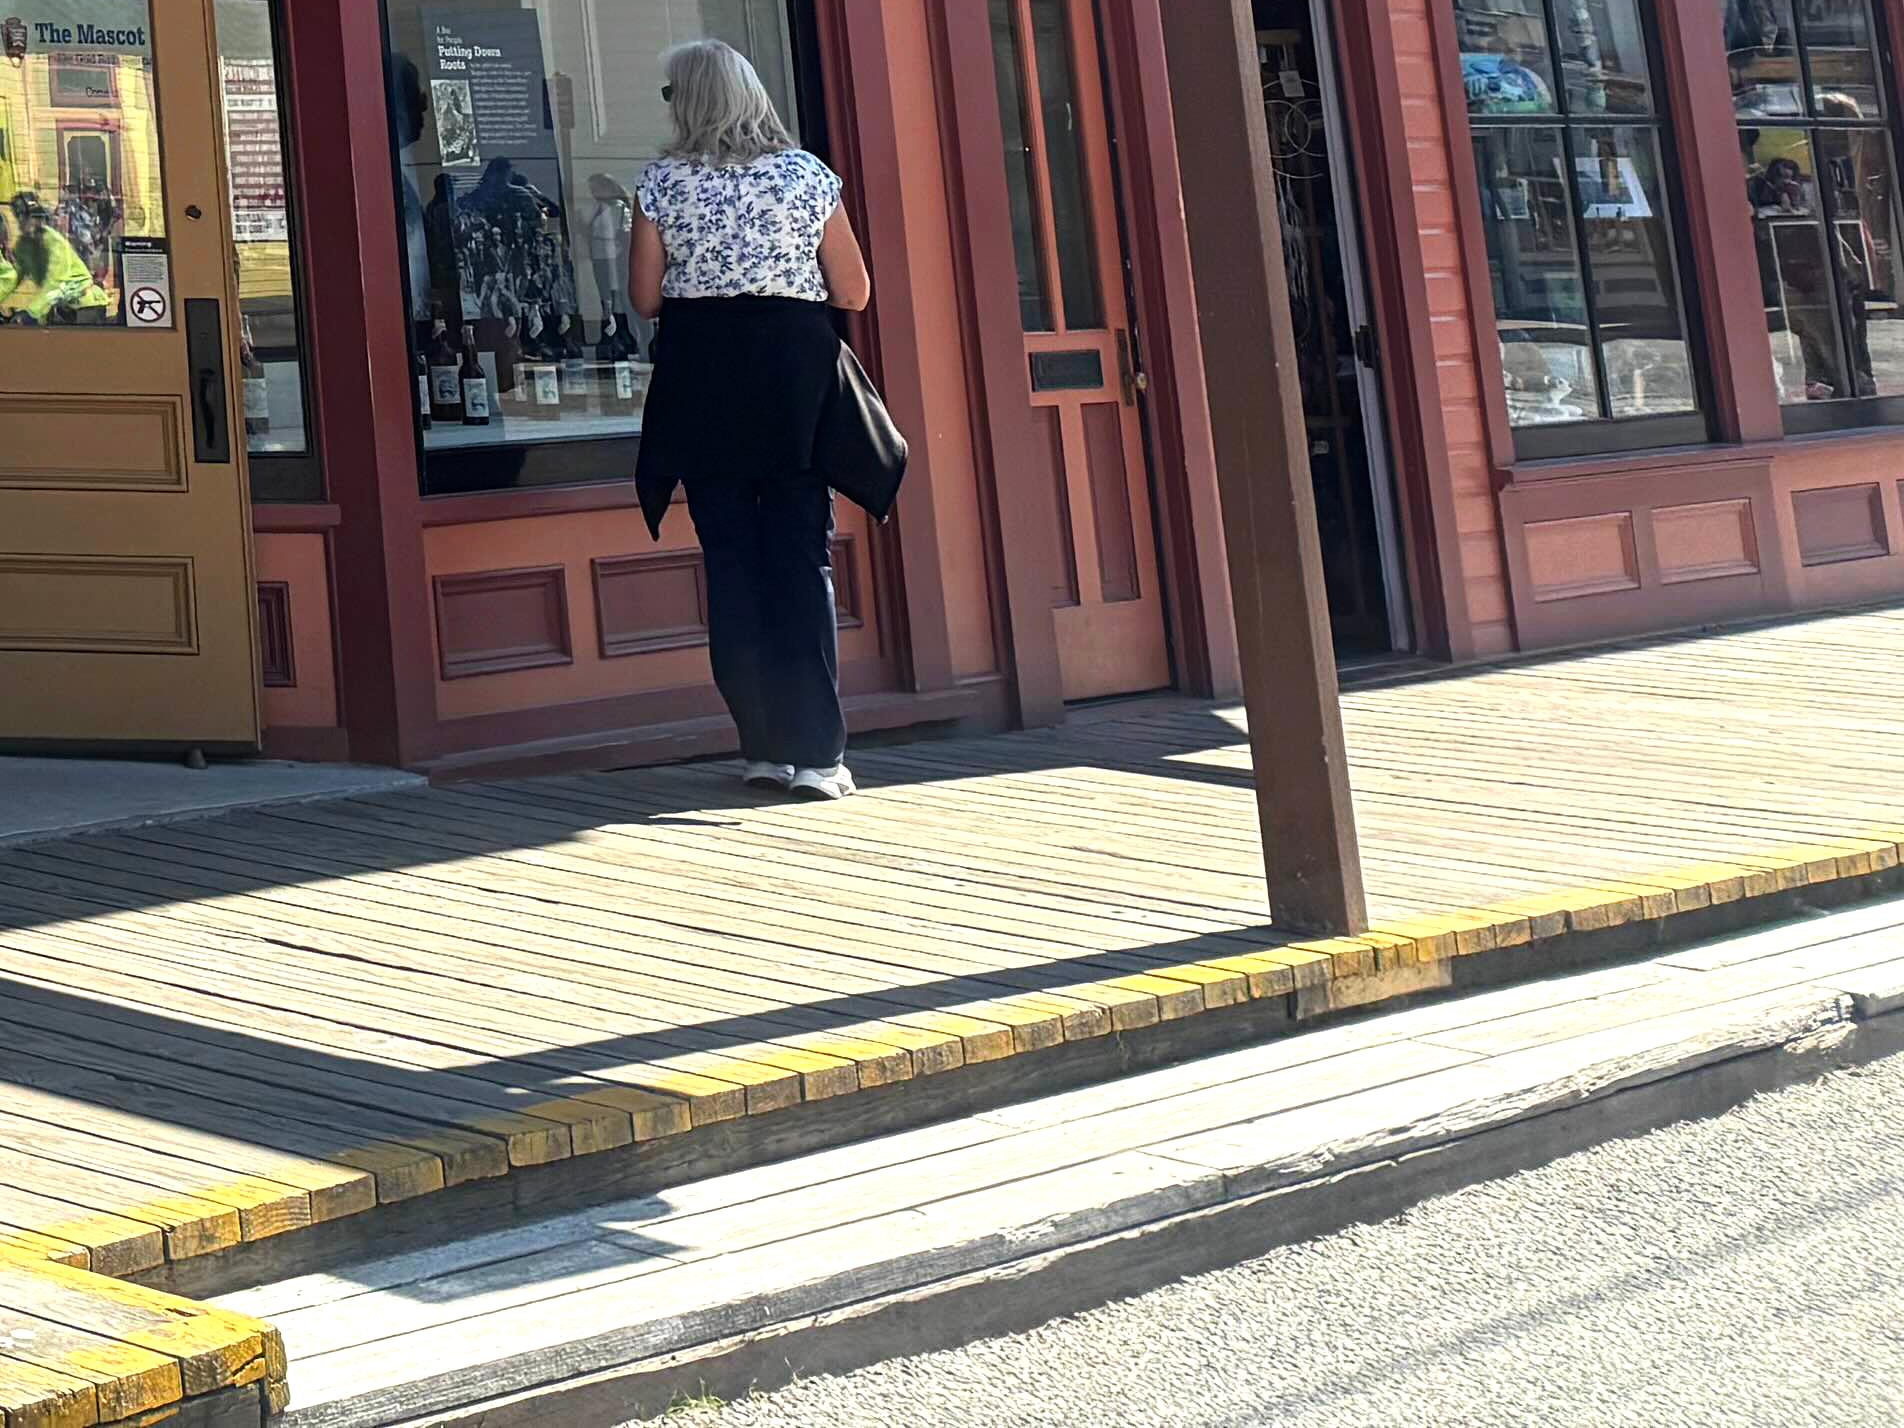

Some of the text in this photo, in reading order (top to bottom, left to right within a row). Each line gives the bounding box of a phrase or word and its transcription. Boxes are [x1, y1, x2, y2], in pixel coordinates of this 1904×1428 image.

[35, 23, 145, 45] The Mascot
[438, 45, 472, 59] Putting
[440, 59, 466, 70] Roots
